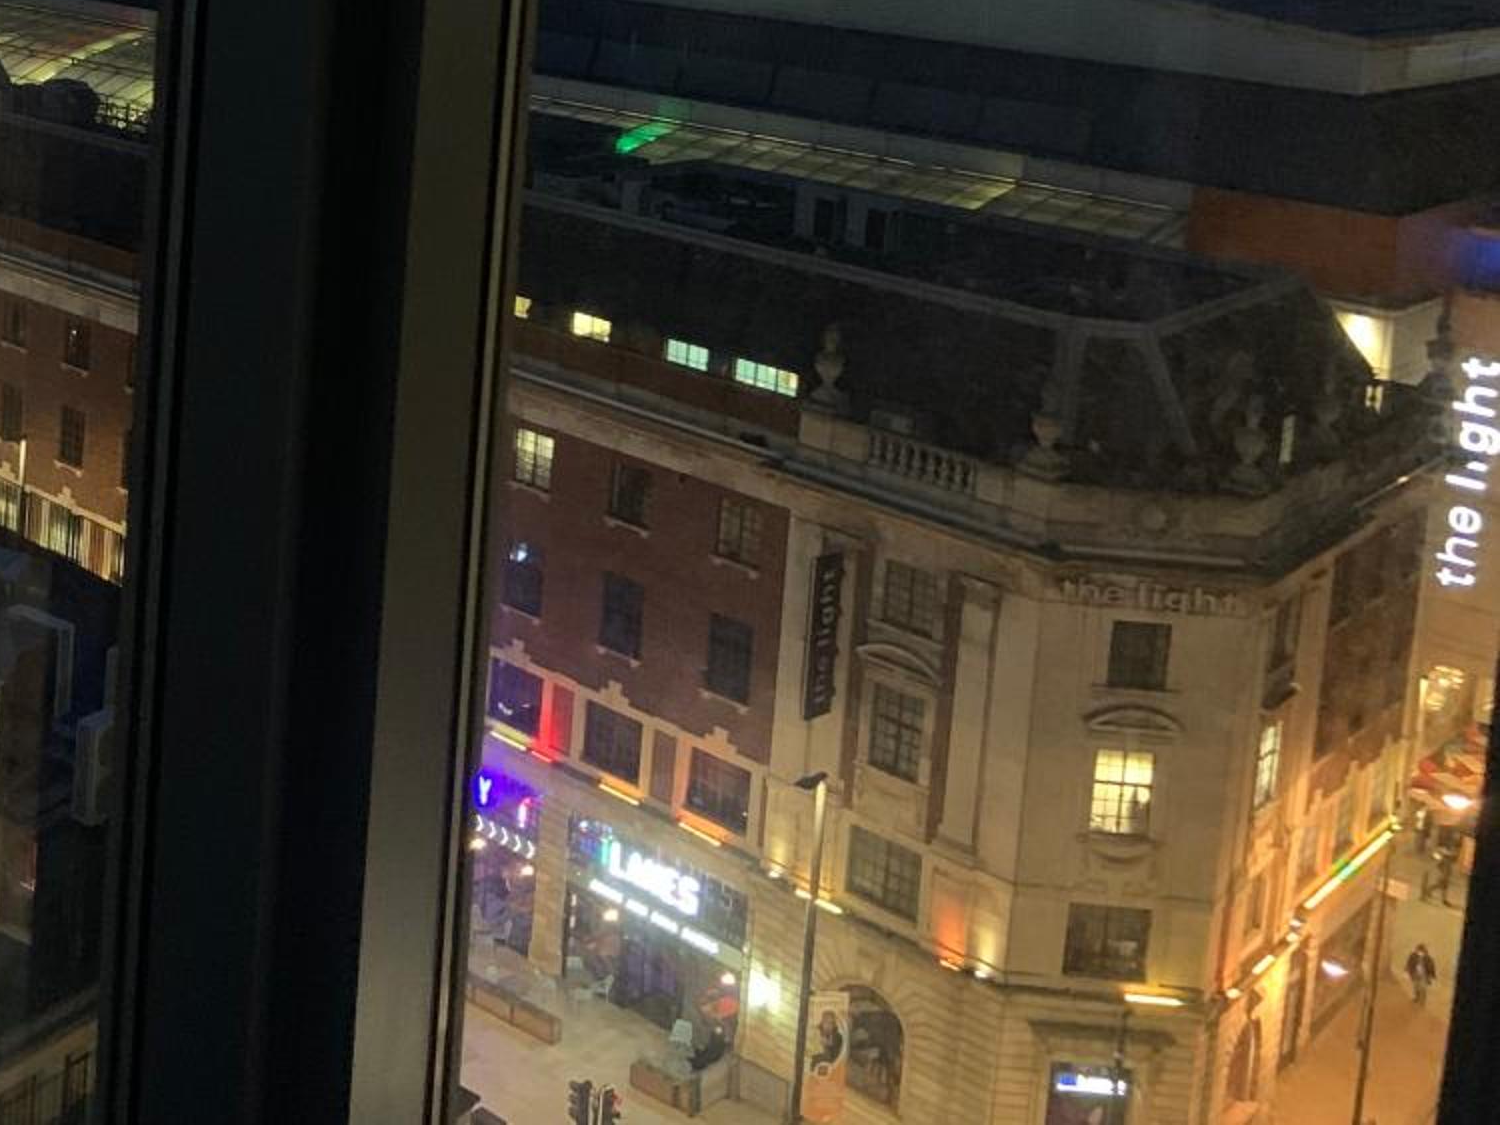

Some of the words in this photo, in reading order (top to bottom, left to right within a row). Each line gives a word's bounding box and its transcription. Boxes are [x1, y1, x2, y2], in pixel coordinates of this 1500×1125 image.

[1445, 357, 1500, 491] light
[1436, 506, 1483, 587] the
[1061, 578, 1124, 604] the
[1138, 581, 1238, 614] light
